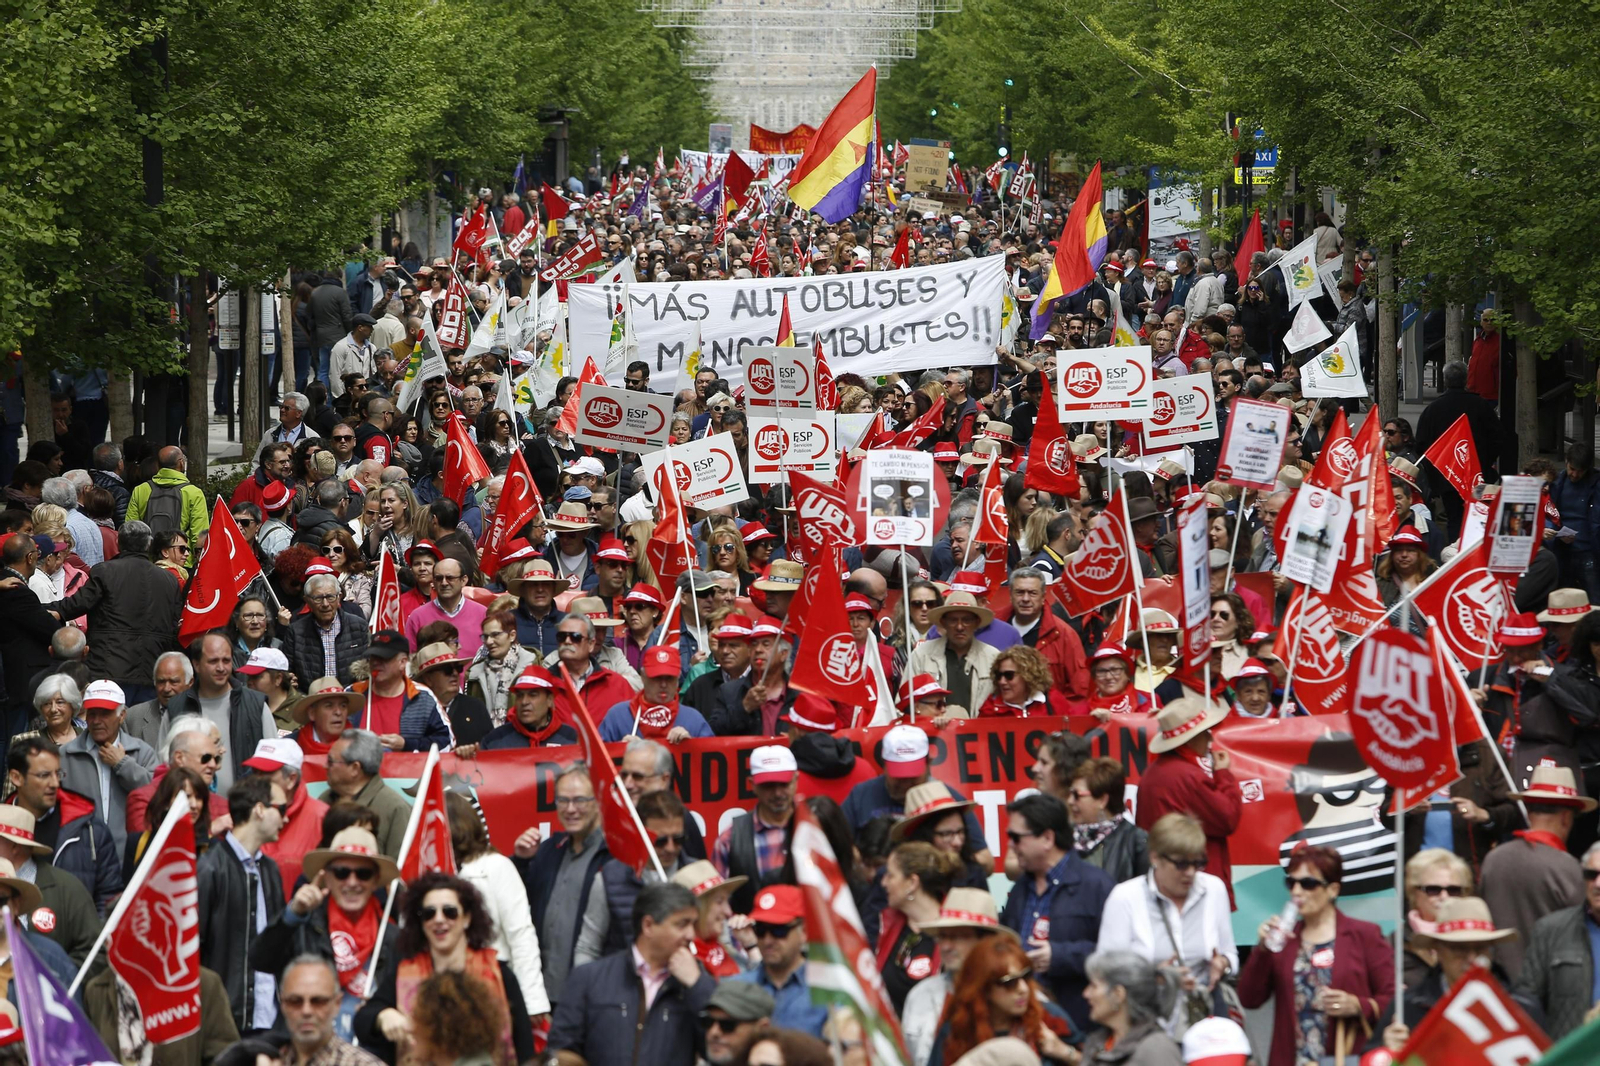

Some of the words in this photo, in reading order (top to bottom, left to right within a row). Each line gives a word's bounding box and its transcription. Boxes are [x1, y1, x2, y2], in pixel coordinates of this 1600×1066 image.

[1255, 152, 1272, 161] AXI
[731, 275, 937, 320] AUTOBUSES
[957, 270, 978, 299] Y
[751, 364, 774, 379] UGT
[1069, 367, 1098, 381] UGT
[589, 400, 619, 416] UGT
[801, 491, 856, 540] UGT
[1361, 637, 1433, 712] UGT
